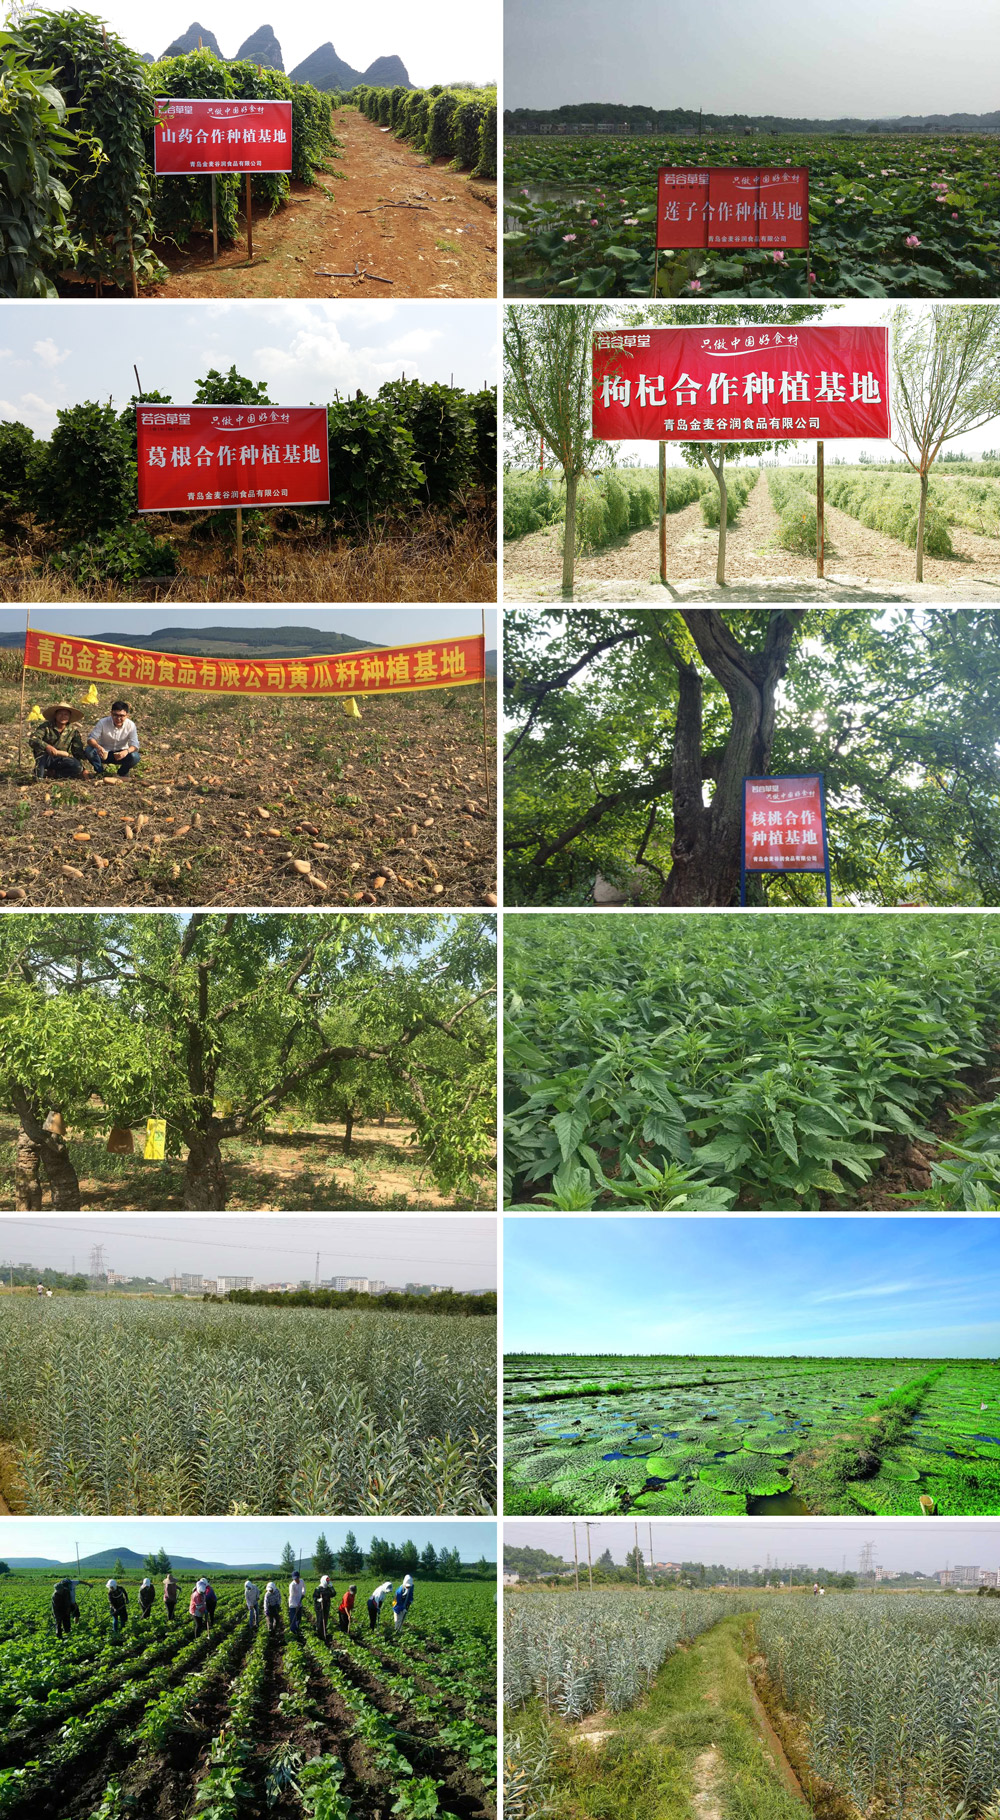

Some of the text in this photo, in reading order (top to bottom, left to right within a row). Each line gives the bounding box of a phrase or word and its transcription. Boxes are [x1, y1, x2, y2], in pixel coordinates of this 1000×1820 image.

[206, 105, 265, 115] 只做中国好食材
[162, 128, 287, 144] 山药合作种植基地
[189, 160, 262, 168] 青岛金麦谷润食品有限公司
[664, 174, 709, 184] 若谷草堂
[732, 172, 800, 186] 只做中国好食材
[664, 201, 803, 222] 莲子合作种植基地
[700, 331, 799, 351] 只做中国好食材
[600, 371, 882, 408] 枸杞合作种植基地
[141, 413, 191, 425] 若谷草堂
[210, 410, 290, 426] 只做中国好食材
[664, 417, 821, 431] 青岛金麦谷润食品有限公司
[146, 443, 321, 468] 葛根合作种植基地
[187, 488, 289, 501] 青岛金麦谷润食品有限公司
[37, 638, 466, 690] 青岛金麦谷润食品有限公司黄瓜籽种植基地
[751, 810, 816, 826] 核桃合作
[751, 829, 818, 846] 种植基地
